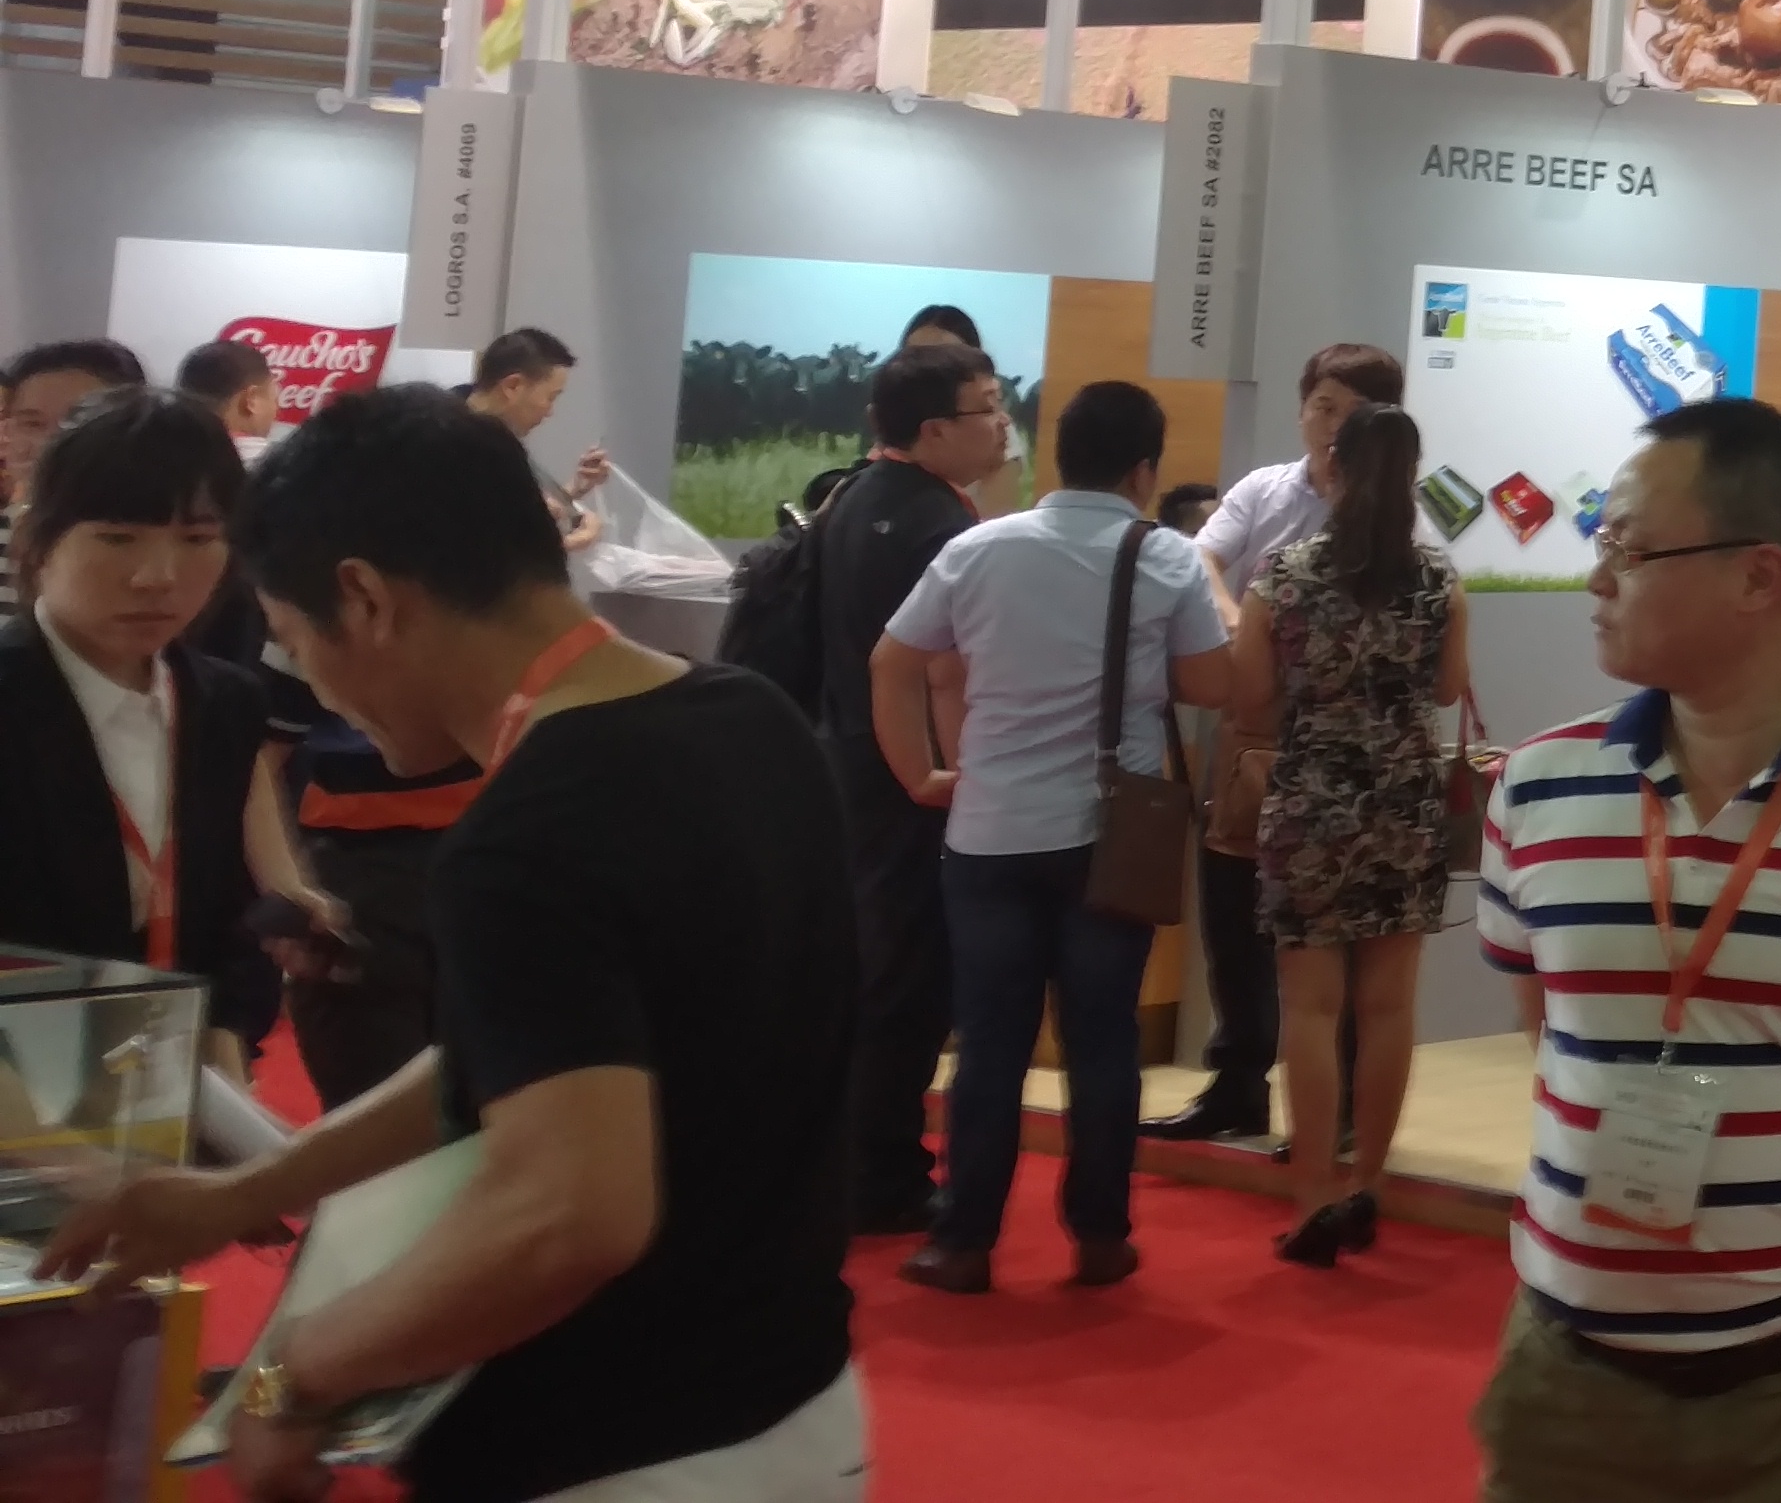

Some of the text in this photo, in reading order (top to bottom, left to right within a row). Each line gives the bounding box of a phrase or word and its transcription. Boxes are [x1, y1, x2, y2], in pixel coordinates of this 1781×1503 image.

[1420, 144, 1658, 197] ARRE BEEF SA
[1190, 107, 1226, 349] ARRE BEEF SA #2082
[444, 232, 469, 318] LOGROS
